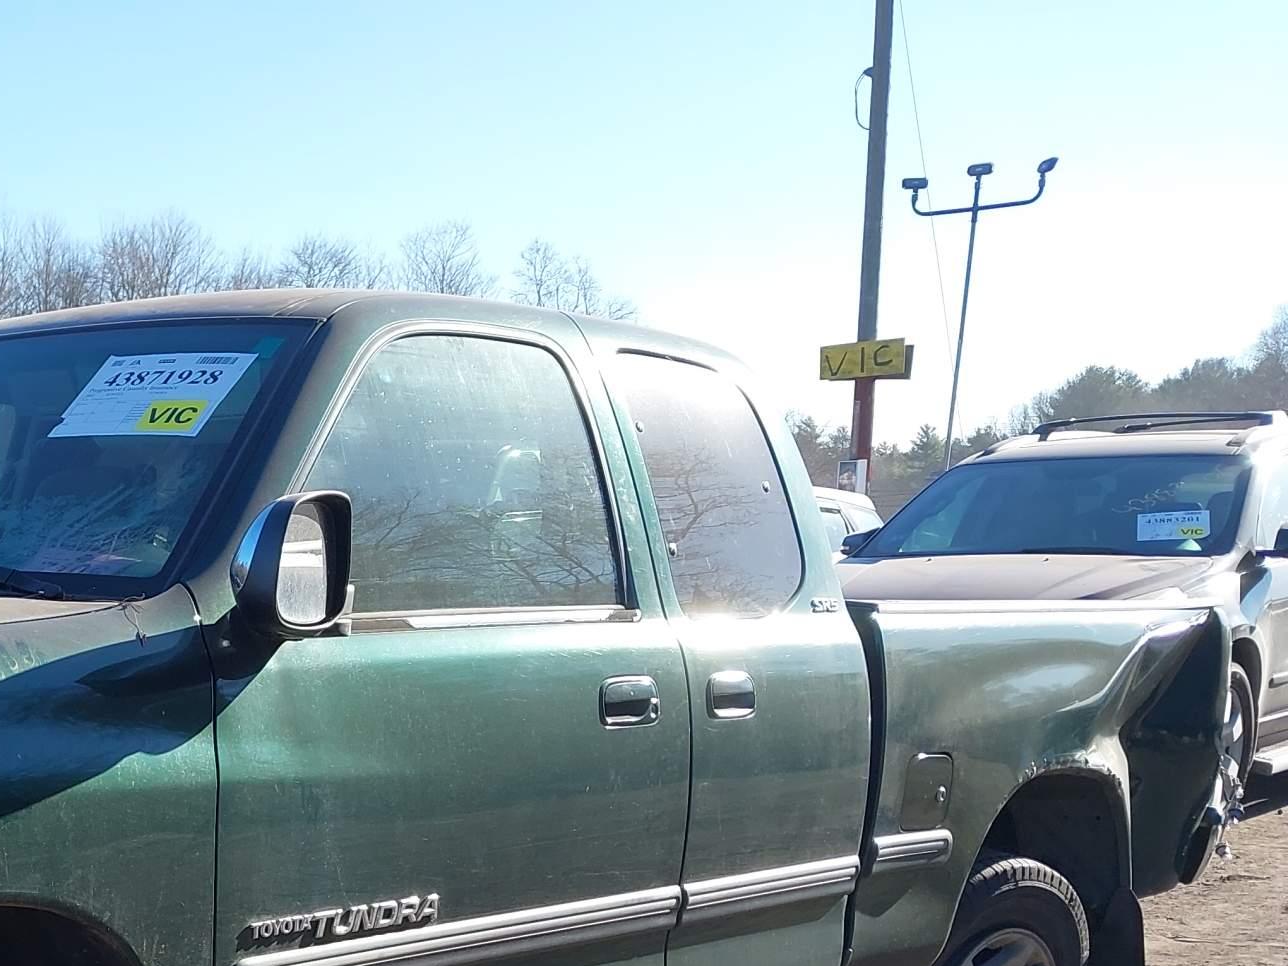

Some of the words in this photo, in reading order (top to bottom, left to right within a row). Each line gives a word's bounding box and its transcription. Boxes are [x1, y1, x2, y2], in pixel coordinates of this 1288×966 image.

[824, 345, 893, 377] VIC
[103, 369, 224, 387] 43871928
[148, 406, 198, 424] VIC
[1180, 528, 1204, 536] VIC
[810, 599, 840, 614] SR5
[250, 915, 312, 940] TOYOTA
[312, 893, 441, 938] TUNDRA
